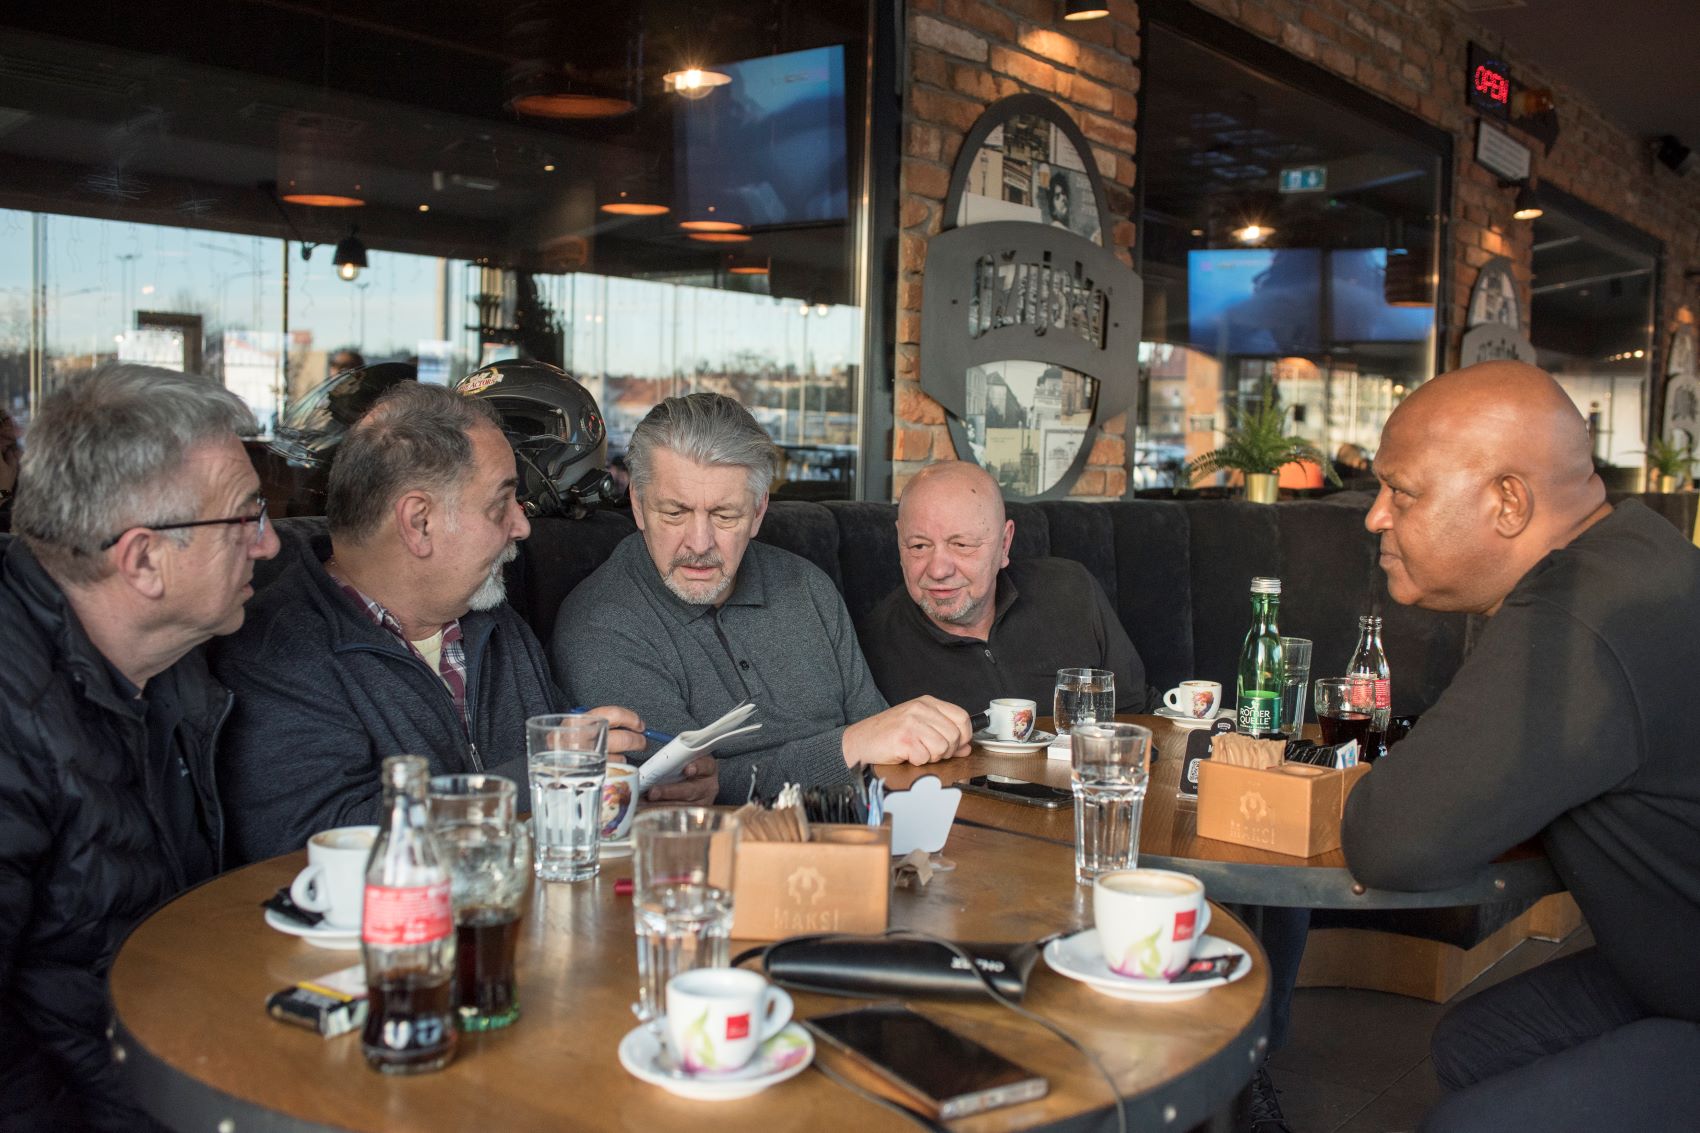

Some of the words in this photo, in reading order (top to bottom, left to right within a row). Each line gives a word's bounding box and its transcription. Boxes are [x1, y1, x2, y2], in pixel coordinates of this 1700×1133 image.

[1474, 65, 1510, 105] OPEN
[1239, 715, 1271, 726] QUELLE
[773, 906, 839, 931] MAKSI
